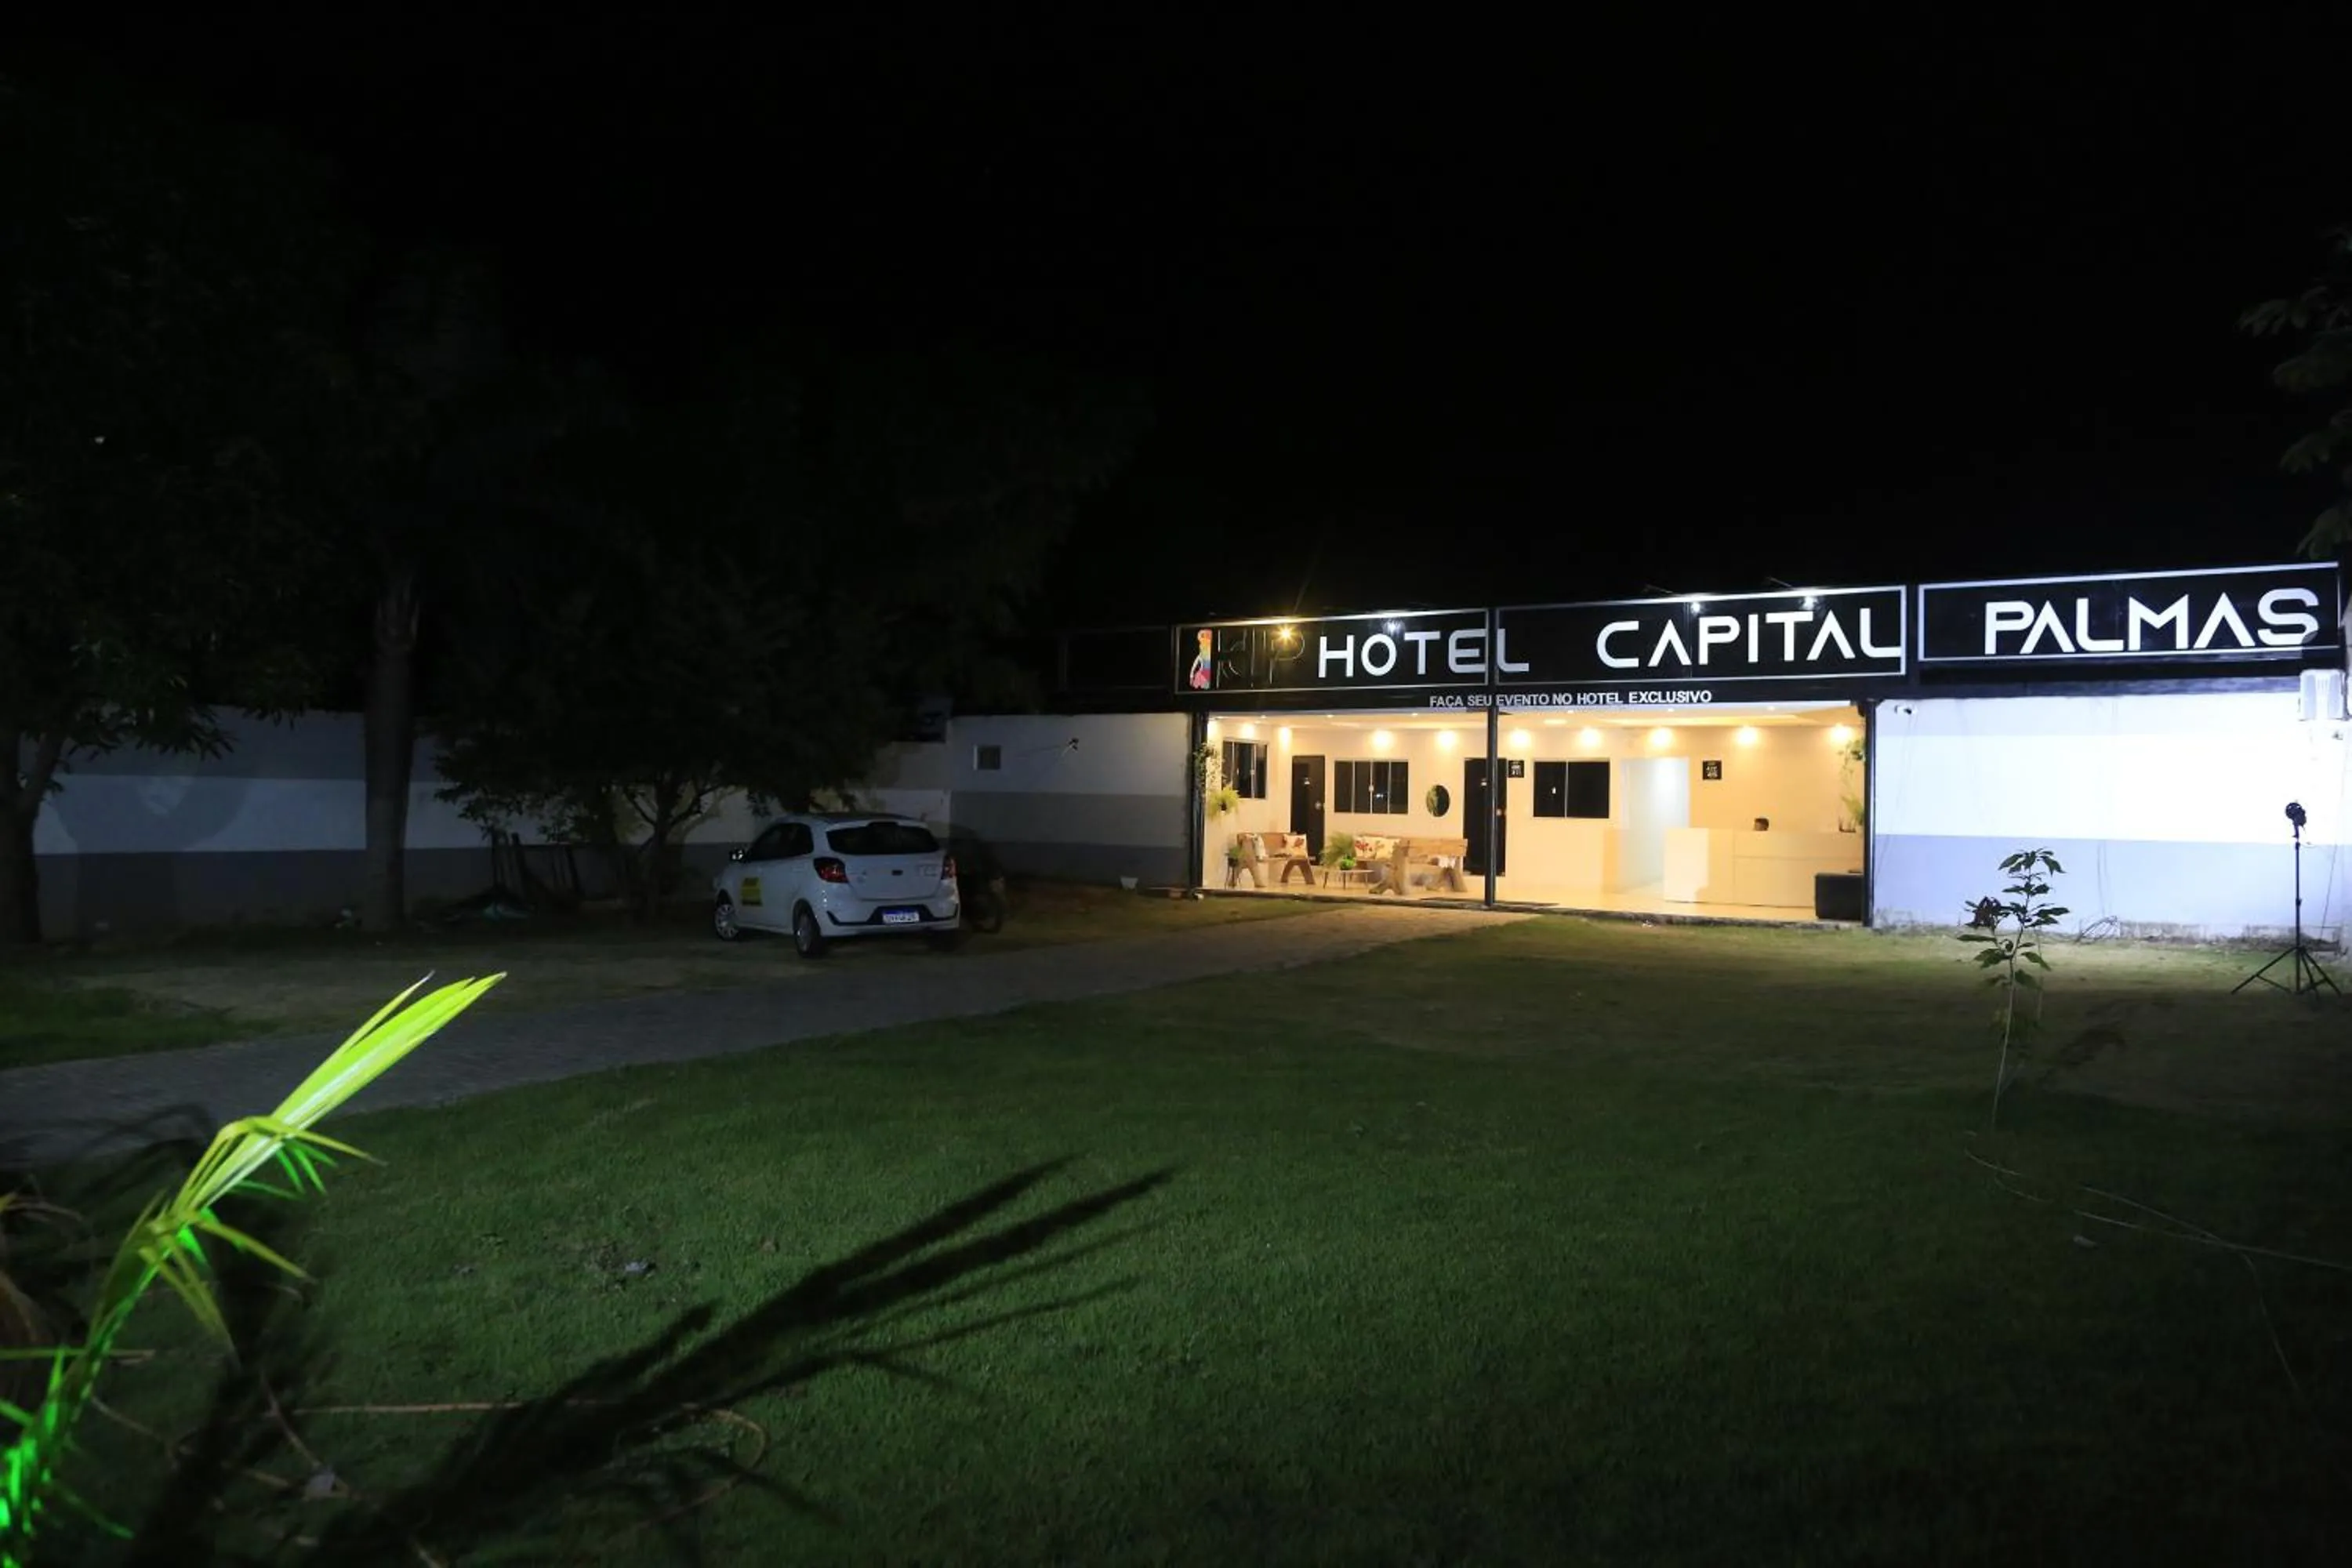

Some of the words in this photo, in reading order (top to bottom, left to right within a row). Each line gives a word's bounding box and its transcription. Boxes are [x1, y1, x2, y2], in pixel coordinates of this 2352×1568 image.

[1318, 629, 1530, 677] HOTEL
[1597, 608, 1902, 669] CAPITAL
[1984, 587, 2319, 655] PALMAS
[1429, 695, 1464, 710] FAÇA
[1467, 695, 1492, 707] SEU
[1496, 693, 1550, 706] EVENTO
[1552, 692, 1573, 705] NO
[1577, 691, 1623, 705] HOTEL
[1628, 690, 1711, 703] EXCLUSIVO
